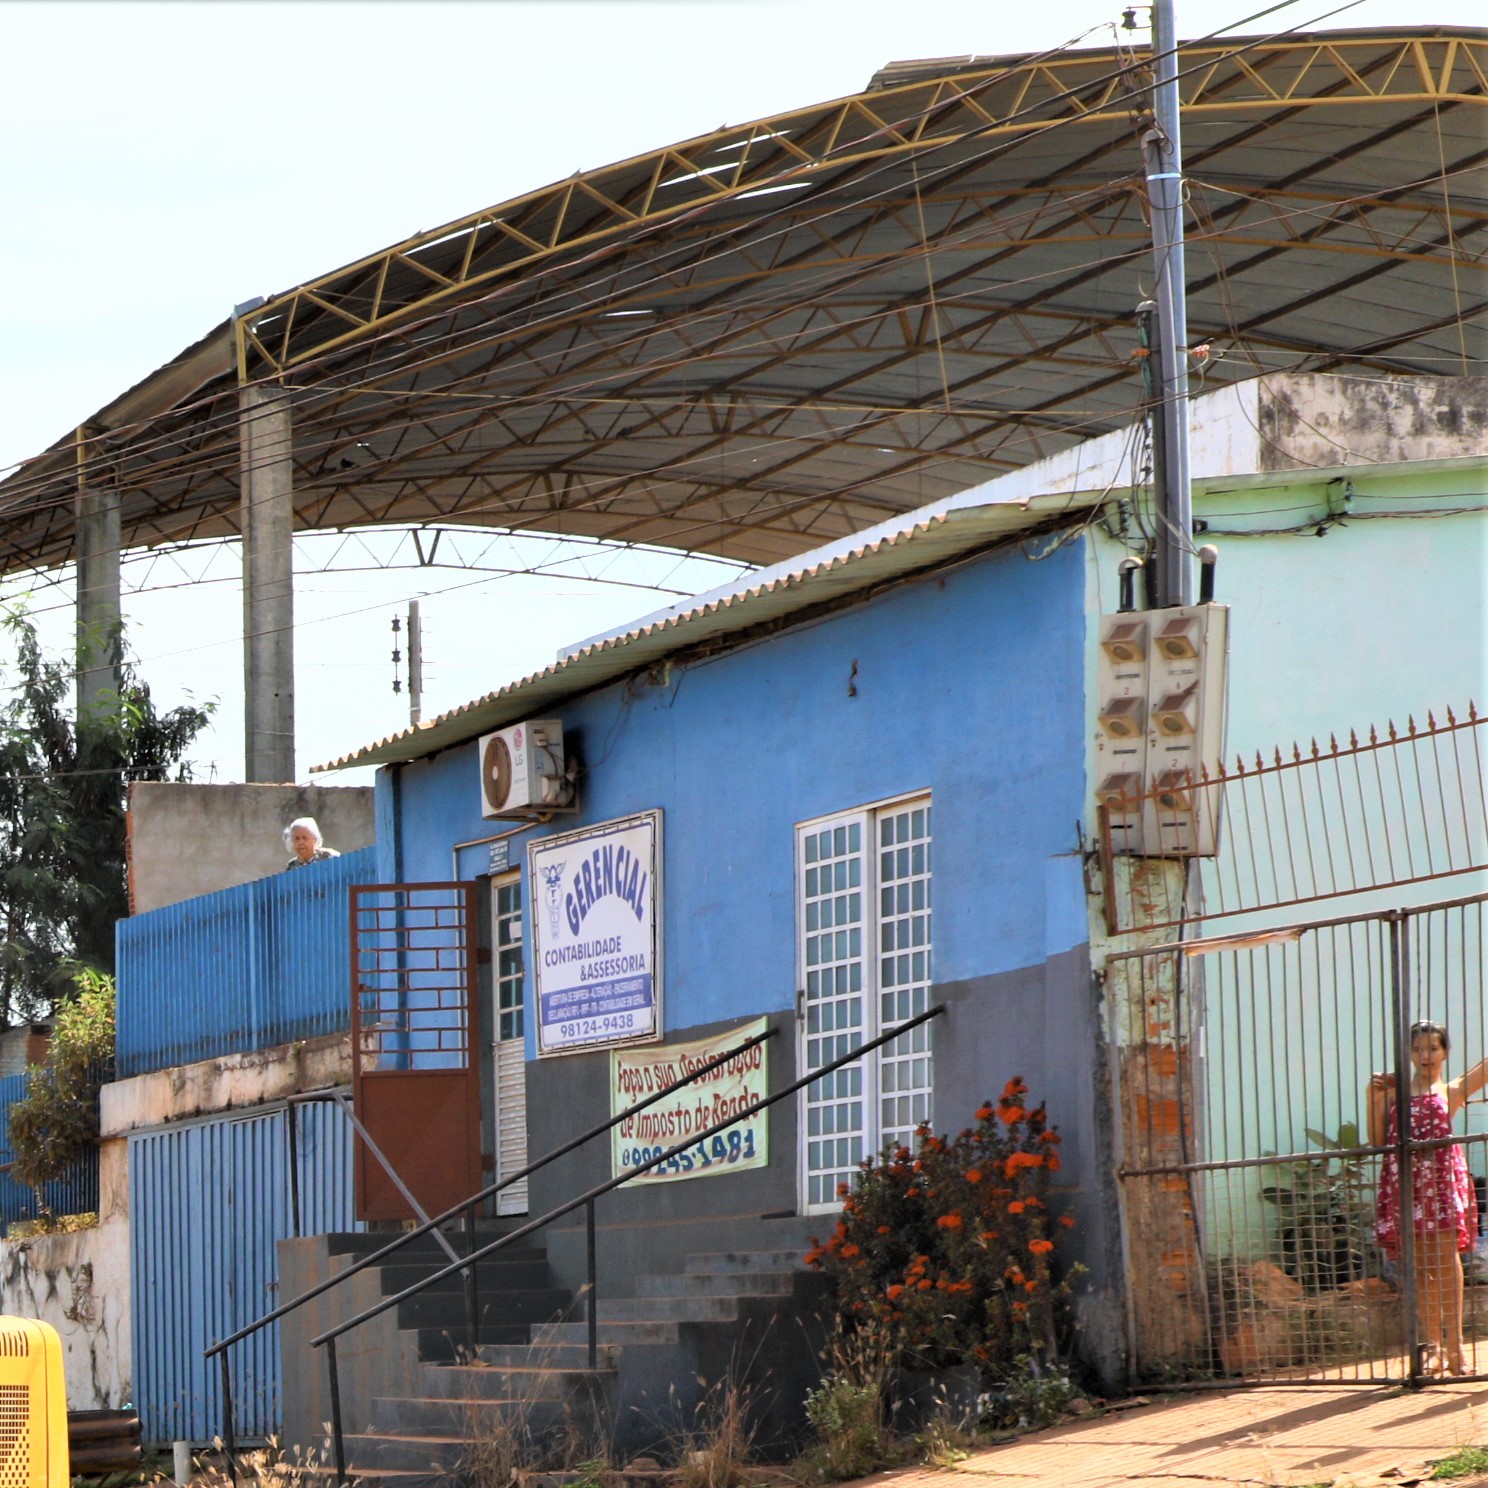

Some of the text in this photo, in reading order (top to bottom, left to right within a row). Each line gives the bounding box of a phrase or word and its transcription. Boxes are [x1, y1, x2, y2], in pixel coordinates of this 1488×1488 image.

[565, 844, 648, 937] GERENCIAL
[545, 935, 622, 967] CONTABILIDADE
[580, 953, 646, 982] &ASSESSORIA
[560, 1013, 634, 1038] 98124-9438
[618, 1061, 644, 1103] Faça
[695, 1097, 710, 1133] de
